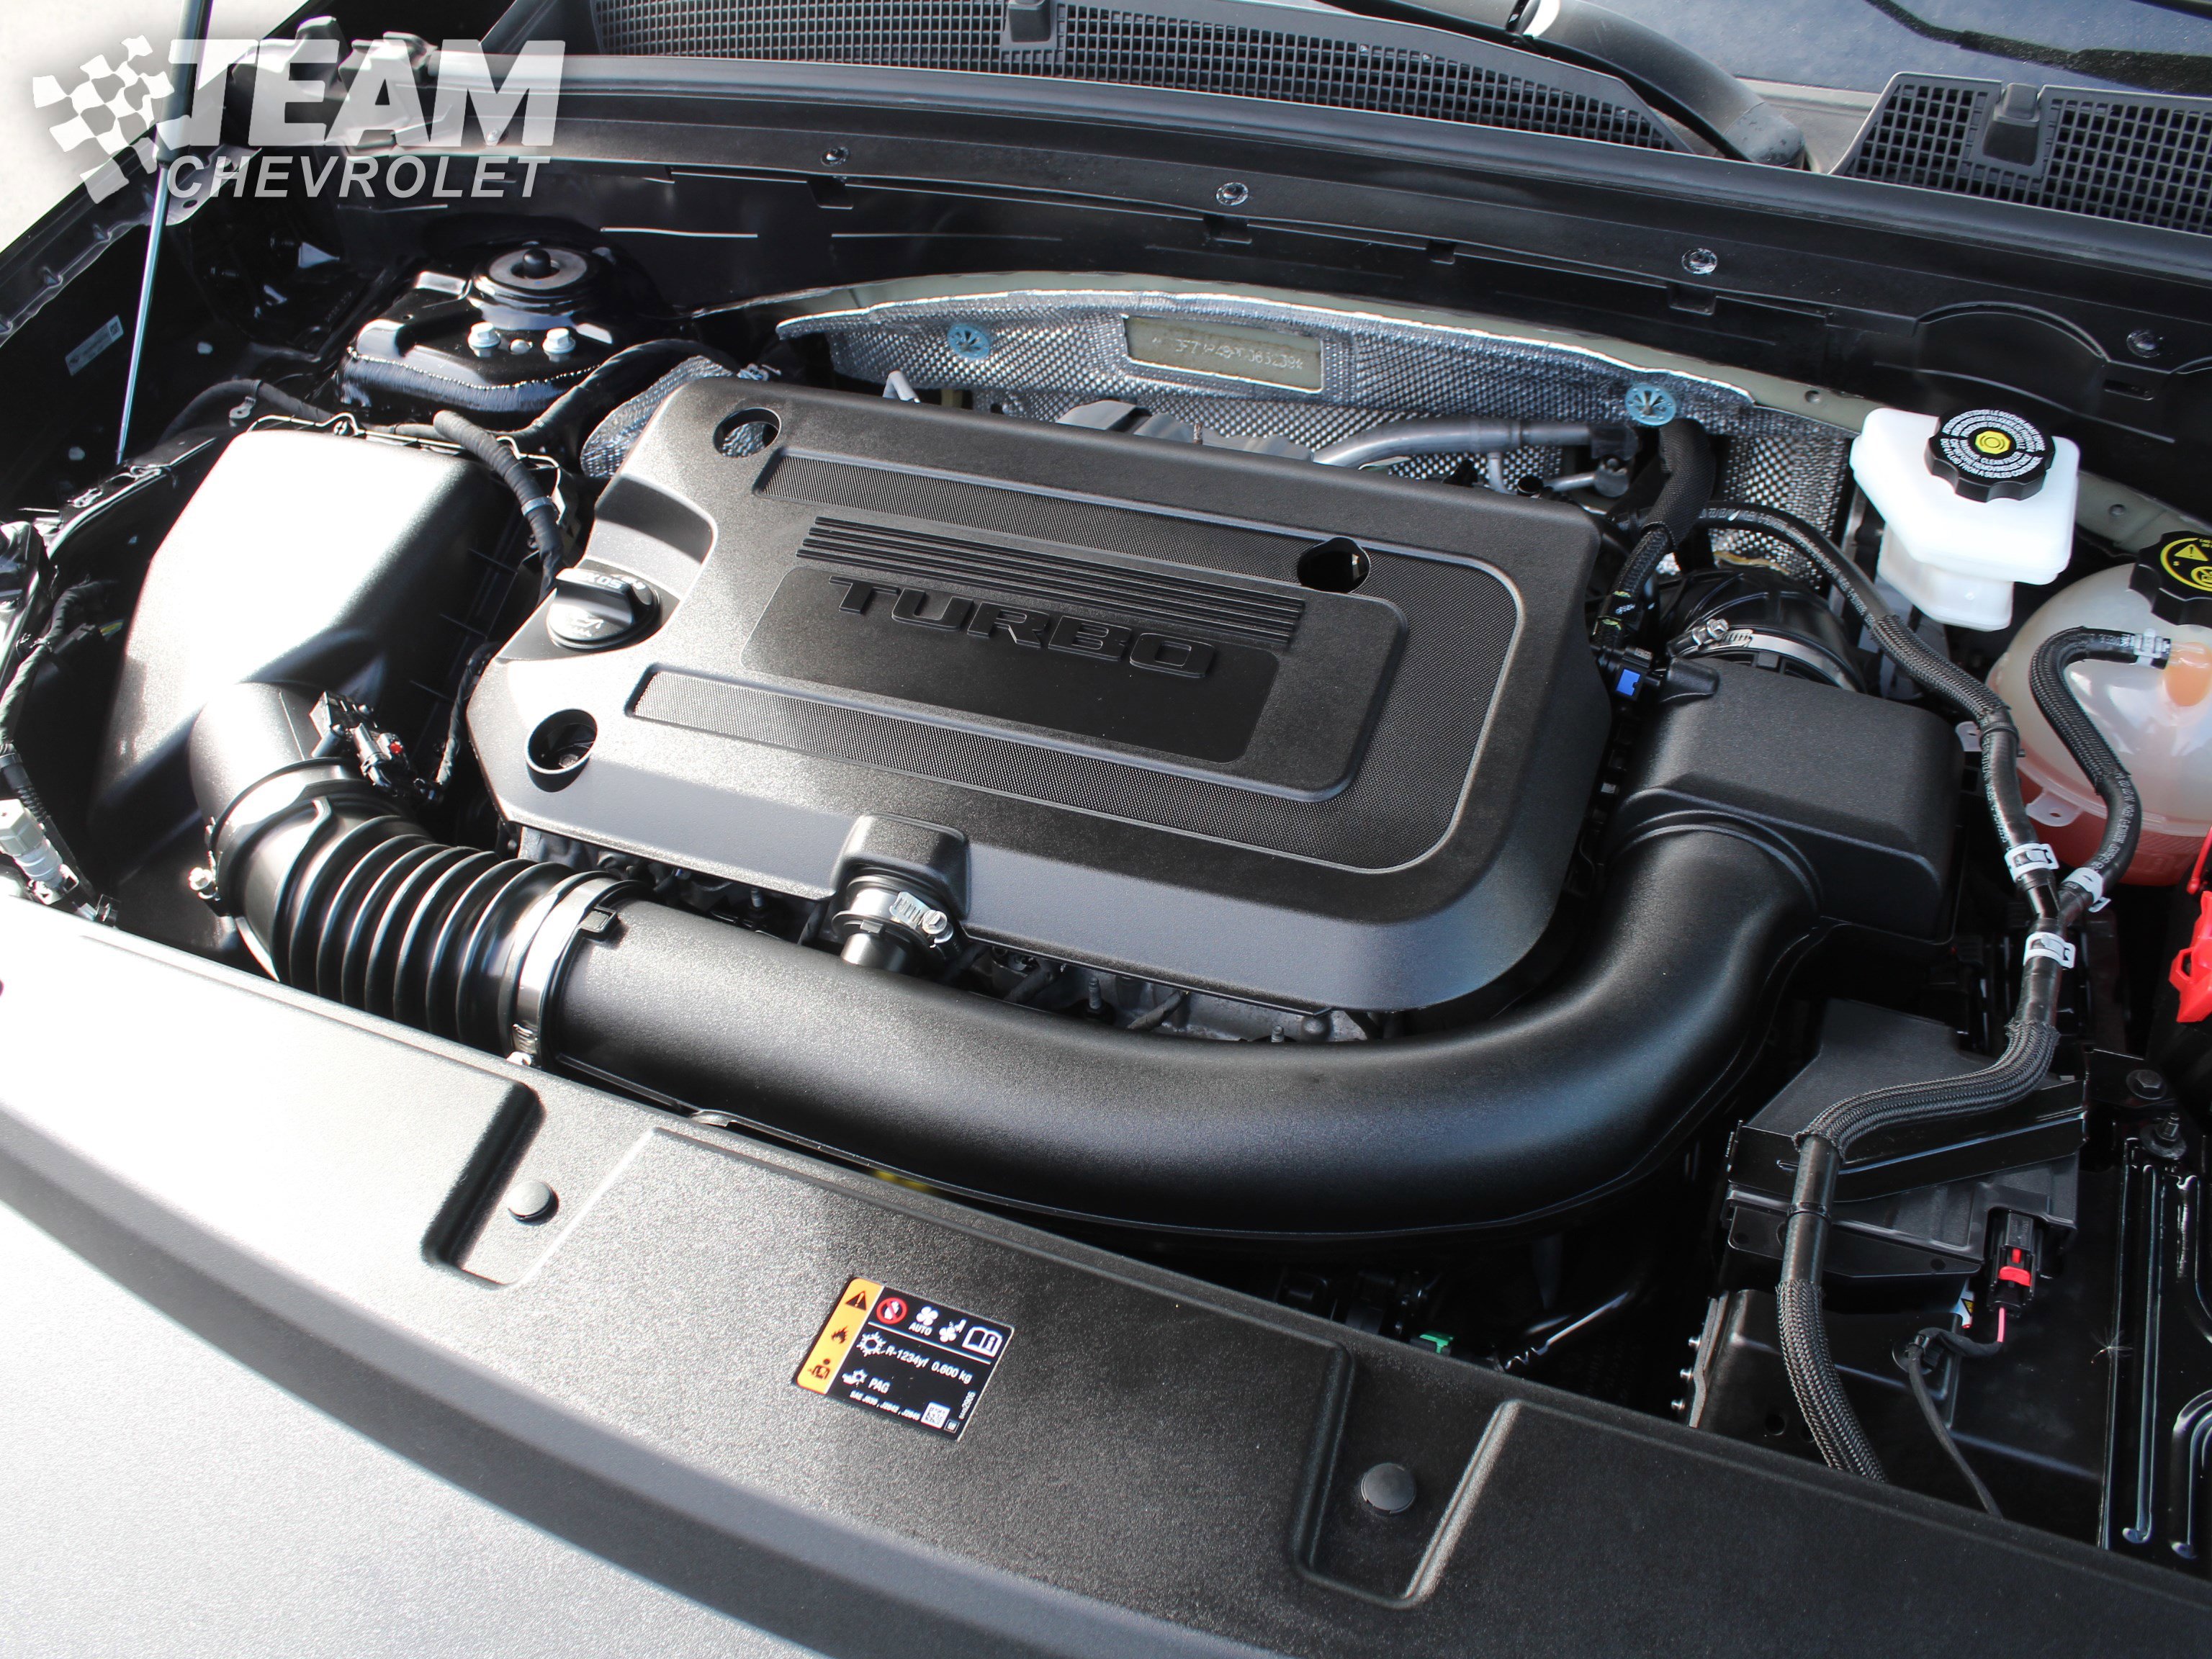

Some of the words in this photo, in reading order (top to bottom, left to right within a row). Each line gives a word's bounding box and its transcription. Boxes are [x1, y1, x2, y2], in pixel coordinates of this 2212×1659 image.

[1940, 438, 1951, 448] DOT
[1949, 438, 1961, 449] CAP
[1945, 450, 1962, 464] FLUID
[1953, 447, 1975, 465] BEFORE
[1980, 457, 2005, 466] CLEAN
[1959, 462, 1979, 475] FROM
[829, 575, 1217, 678] TURBO
[909, 1321, 932, 1336] AUTO
[886, 1346, 929, 1368] R-1234yf
[932, 1360, 959, 1378] 0.600
[958, 1370, 973, 1385] kg
[868, 1377, 891, 1393] PAG
[850, 1390, 863, 1400] SAE
